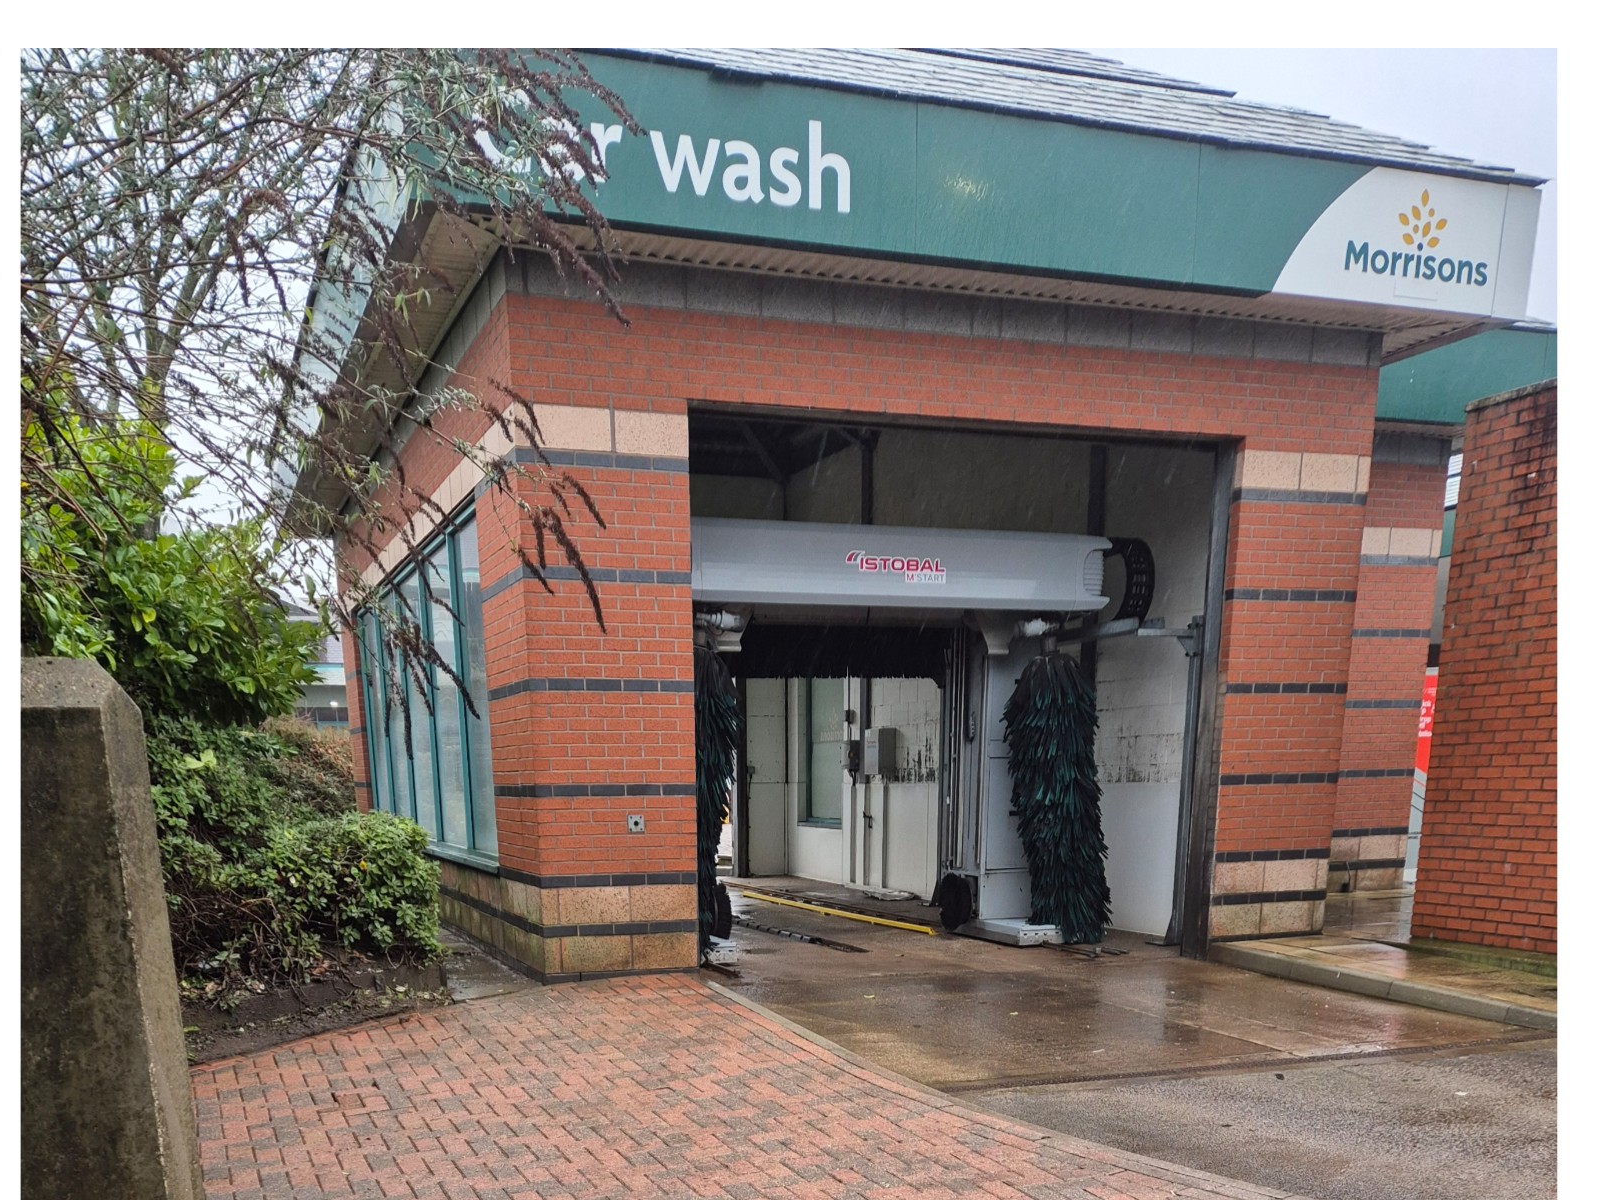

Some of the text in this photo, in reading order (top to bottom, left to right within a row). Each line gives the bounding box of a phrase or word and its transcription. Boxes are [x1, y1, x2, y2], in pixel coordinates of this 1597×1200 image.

[649, 119, 851, 214] wash
[1344, 239, 1489, 287] Morrisons
[859, 556, 945, 573] ISTOBAL
